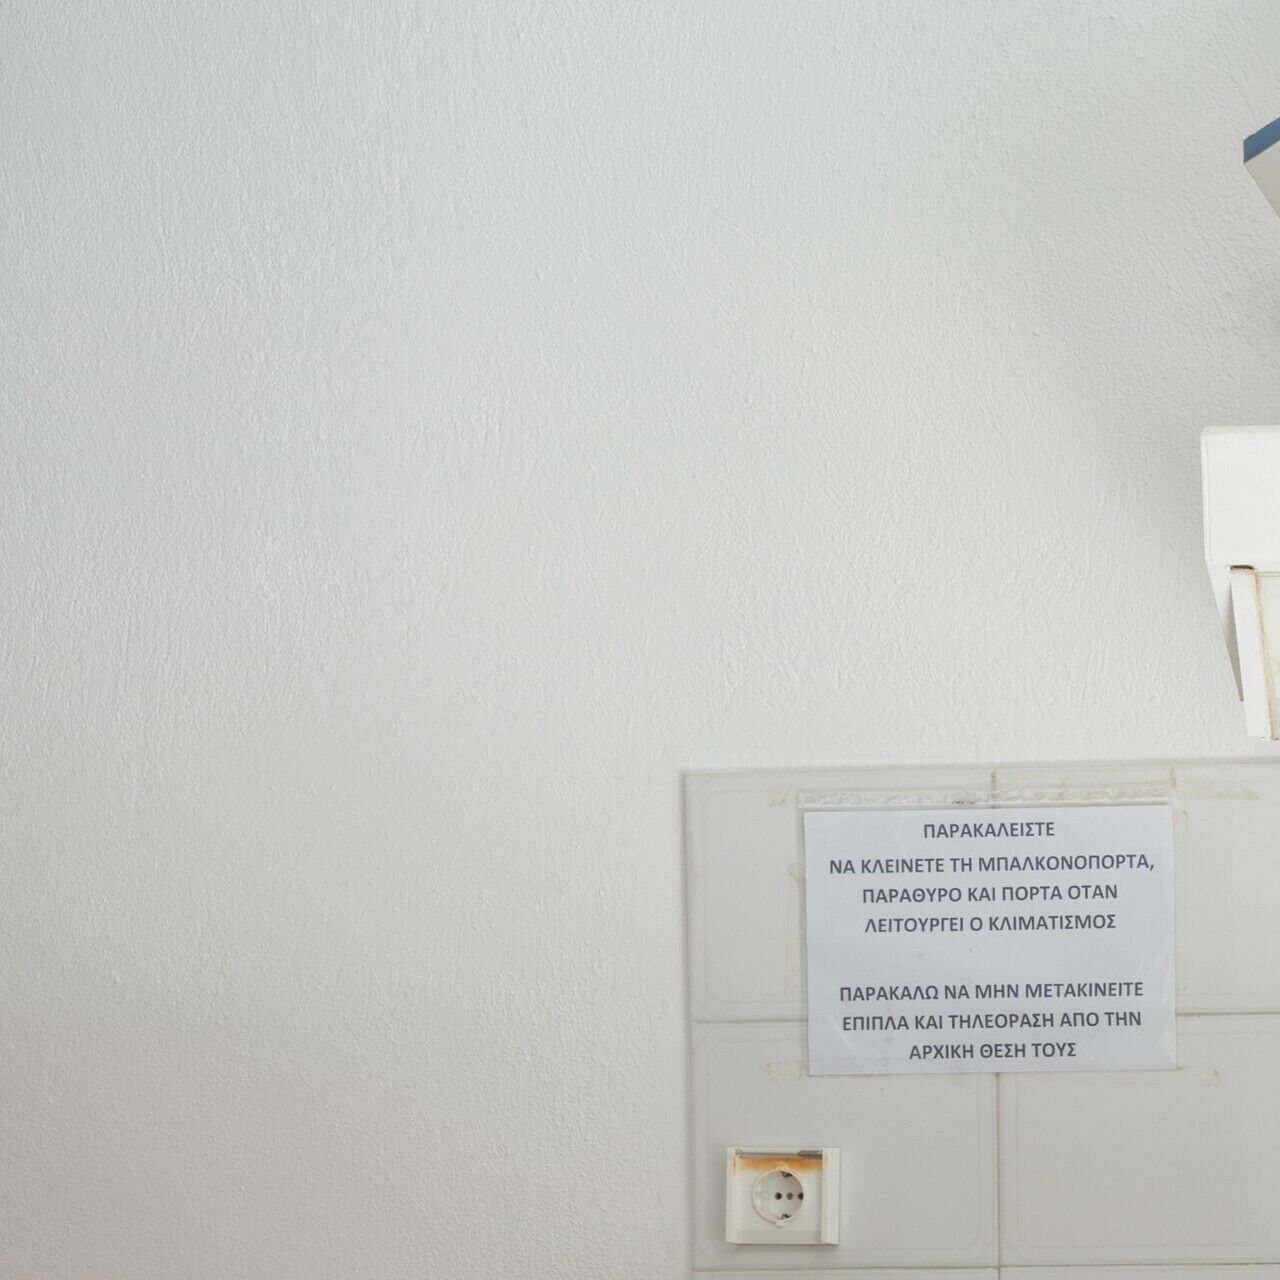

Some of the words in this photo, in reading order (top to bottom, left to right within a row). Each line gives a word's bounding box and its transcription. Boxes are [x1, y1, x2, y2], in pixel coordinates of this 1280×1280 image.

[923, 821, 1055, 839] ΠΑΡΑΚΑΛΕΙΣΤΕ
[829, 859, 856, 874] ΝΑ
[861, 857, 945, 874] ΚΛΕΙΝΕΤΕ
[949, 857, 973, 873] ΤΗ
[978, 854, 1154, 872] ΜΠΑΛΚΟΝΟΠΟΡΤΑ,
[863, 887, 962, 904] ΠΑΡΑΘΥΡΟ
[968, 887, 996, 902] ΚΑΙ
[1002, 885, 1063, 901] ΠΟΡΤΑ
[1067, 884, 1117, 900] ΟΤΑΝ
[864, 917, 964, 933] ΛΕΙΤΟΥΡΓΕΙ
[969, 917, 983, 932] Ο
[989, 914, 1116, 931] ΚΛΙΜΑΤΙΣΜΟΣ
[840, 985, 939, 1002] ΠΑΡΑΚΑΛΩ
[944, 984, 970, 1000] ΝΑ
[975, 983, 1019, 999] ΜΗΝ
[1025, 981, 1143, 999] ΜΕΤΑΚΙΝΕΙΤΕ
[843, 1015, 910, 1031] ΕΠΙΠΛΑ
[915, 1015, 943, 1030] ΚΑΙ
[947, 1013, 1055, 1029] ΤΗΛΕΟΡΑΣΗ
[1059, 1011, 1100, 1027] ΑΠΟ
[1103, 1011, 1141, 1027] ΤΗΝ
[909, 1044, 974, 1060] ΑΡΧΙΚΗ
[979, 1043, 1026, 1059] ΘΕΣΗ
[1031, 1042, 1077, 1058] ΤΟΥΣ
